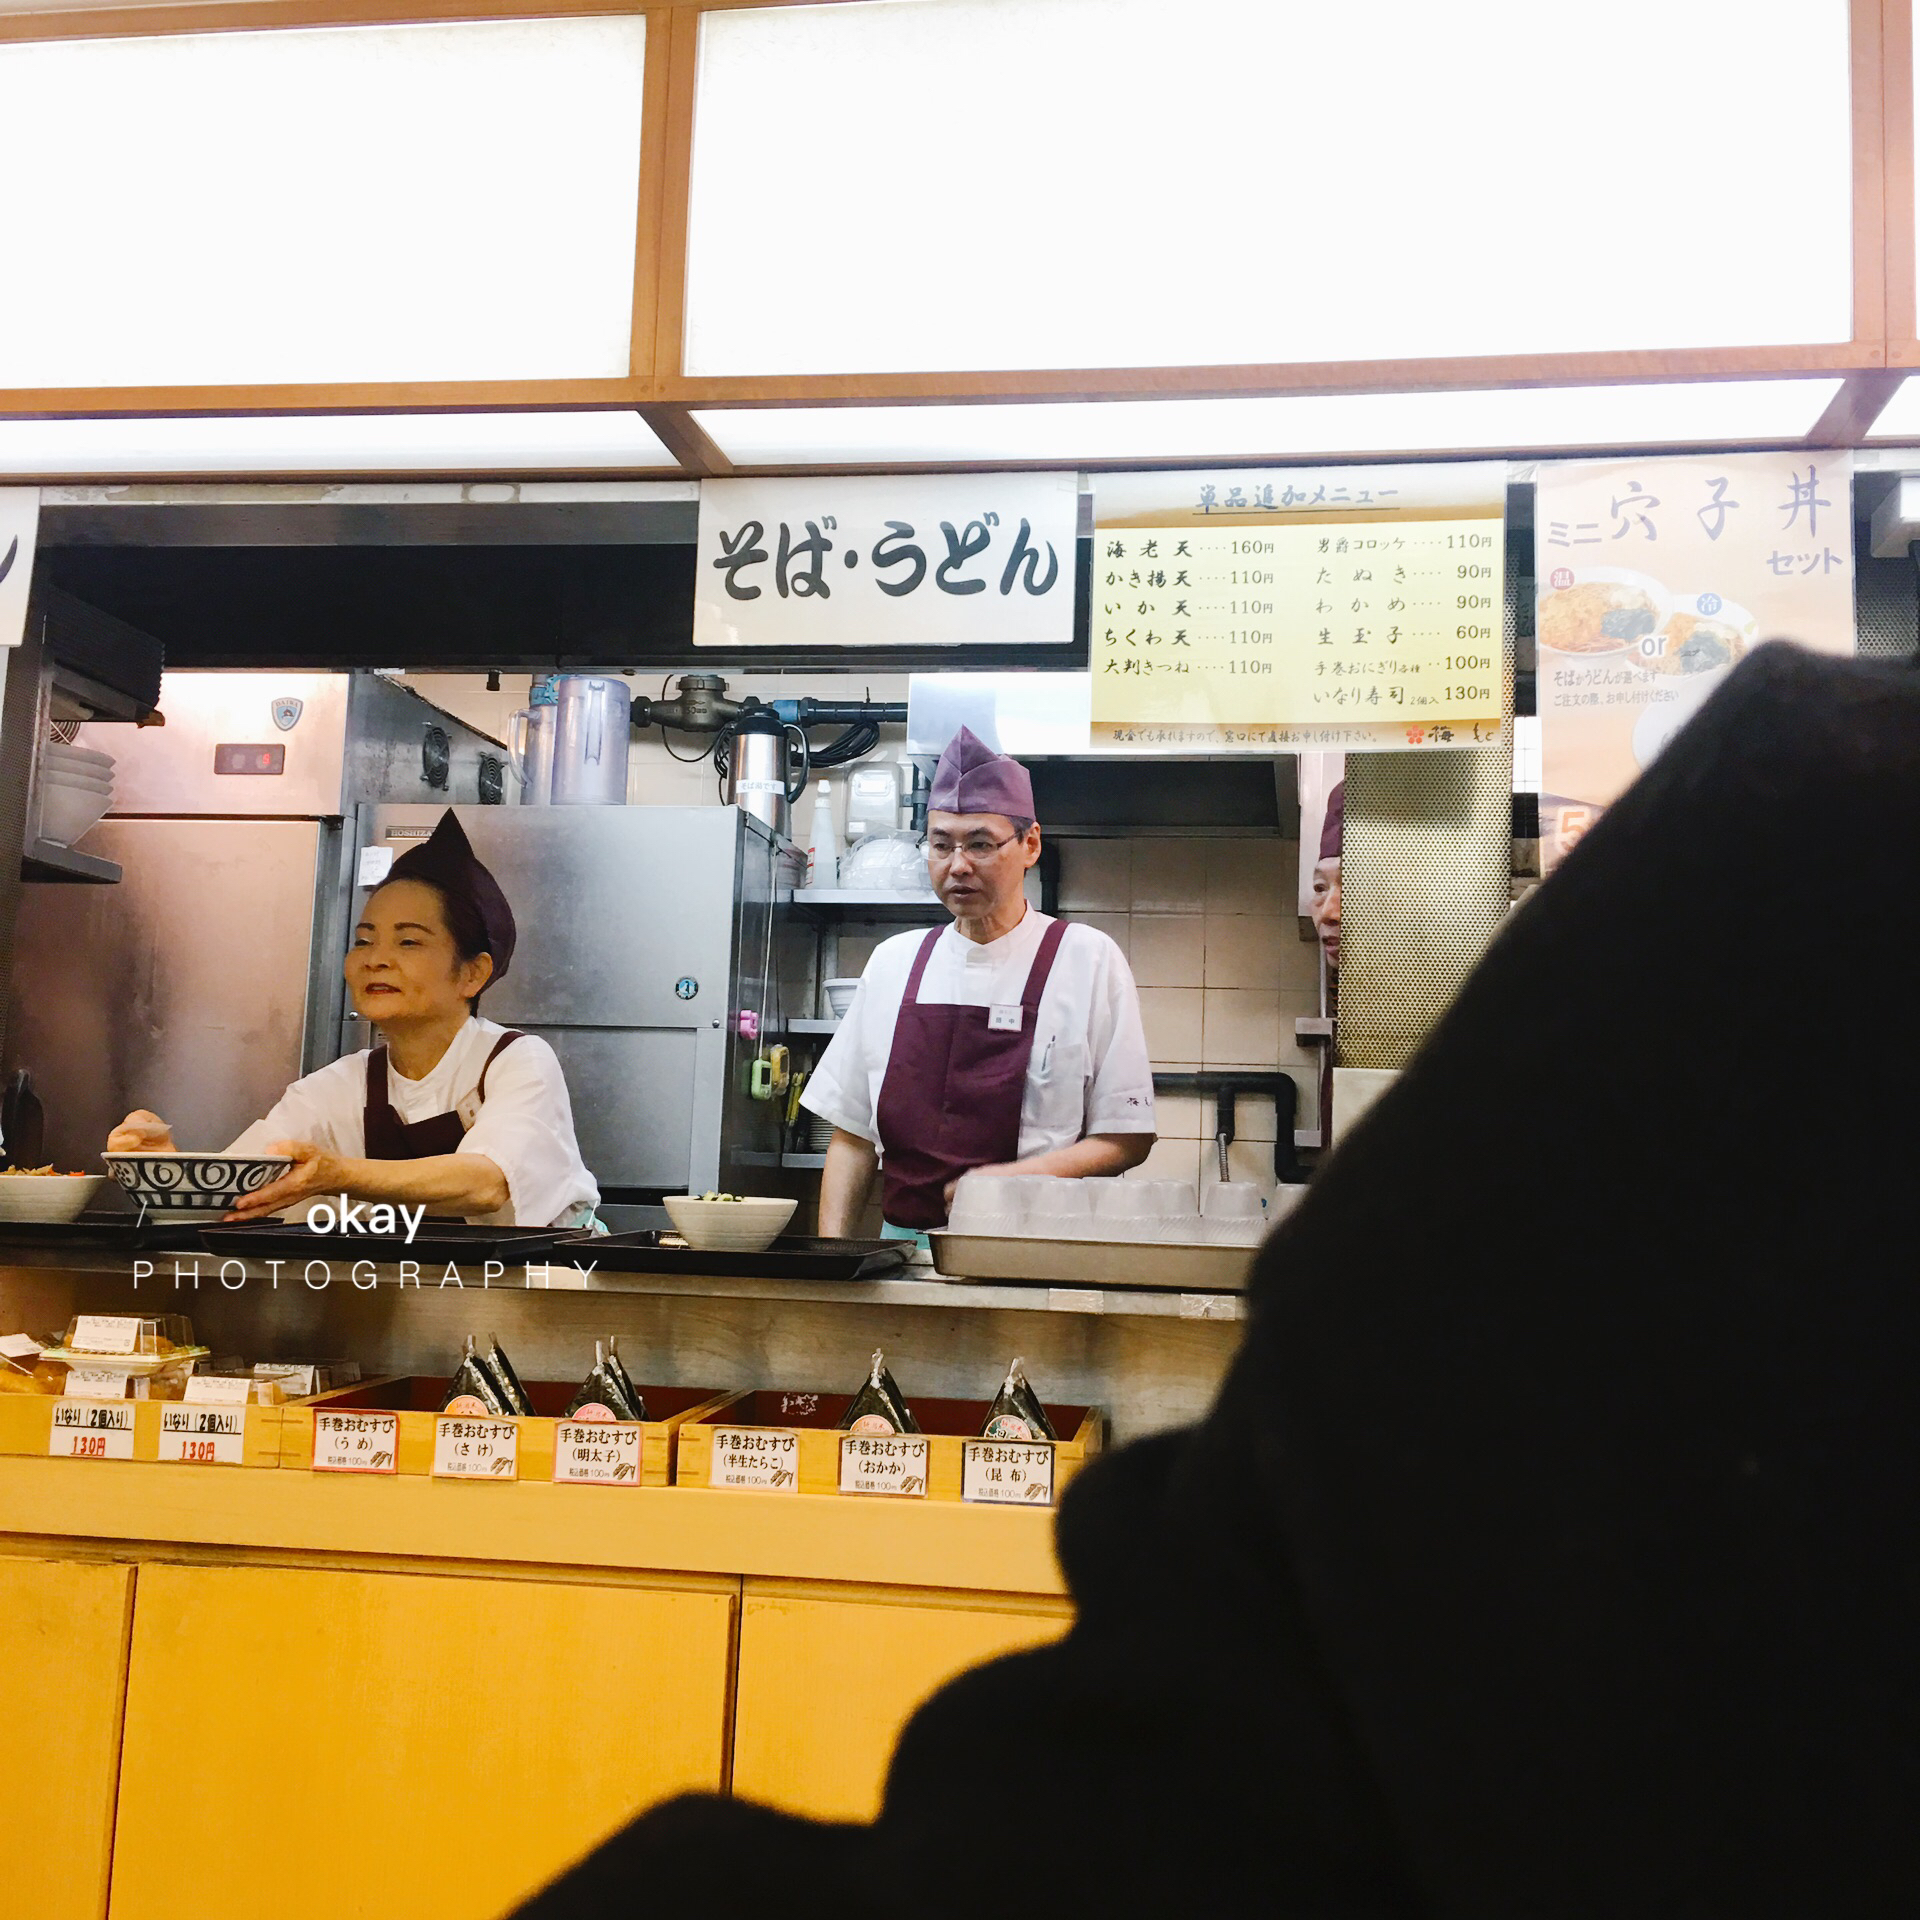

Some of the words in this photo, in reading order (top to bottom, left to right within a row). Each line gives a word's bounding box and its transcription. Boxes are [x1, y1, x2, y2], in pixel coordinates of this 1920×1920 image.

[1106, 539, 1193, 558] 海老天
[1231, 540, 1275, 555] 160円
[1447, 533, 1492, 548] 110円
[713, 511, 1059, 601] そば・うどん
[1766, 547, 1843, 576] セット
[1105, 569, 1192, 589] かき揚天
[1230, 570, 1274, 585] 110円
[1316, 564, 1407, 584] たぬき
[1457, 565, 1492, 579] 90円
[1553, 571, 1572, 587] 温
[1104, 599, 1191, 617] いか天
[1229, 600, 1273, 615] 110円
[1315, 597, 1406, 613] わかめ
[1456, 595, 1491, 610] 90円
[1699, 595, 1719, 612] 冷
[1104, 628, 1191, 647] ちくわ天
[1229, 630, 1273, 644] 110円
[1317, 625, 1403, 645] 生玉子
[1456, 625, 1491, 640] 60円
[1641, 636, 1668, 657] or
[1103, 658, 1190, 675] 大判きつね
[1229, 660, 1272, 674] 110円
[1445, 655, 1490, 670] 100円
[1445, 686, 1490, 700] 130円
[391, 829, 433, 837] HOSHIZA
[319, 1417, 395, 1433] 手巻おむすび
[439, 1423, 515, 1439] 手巻おむすび
[73, 1436, 106, 1454] 130円
[559, 1428, 637, 1446] 手巻おむすび
[716, 1433, 795, 1452] 手巻おむすび
[182, 1440, 215, 1460] 130円
[844, 1440, 925, 1458] 手巻おむすび
[968, 1447, 1049, 1465] 手巻おむすび
